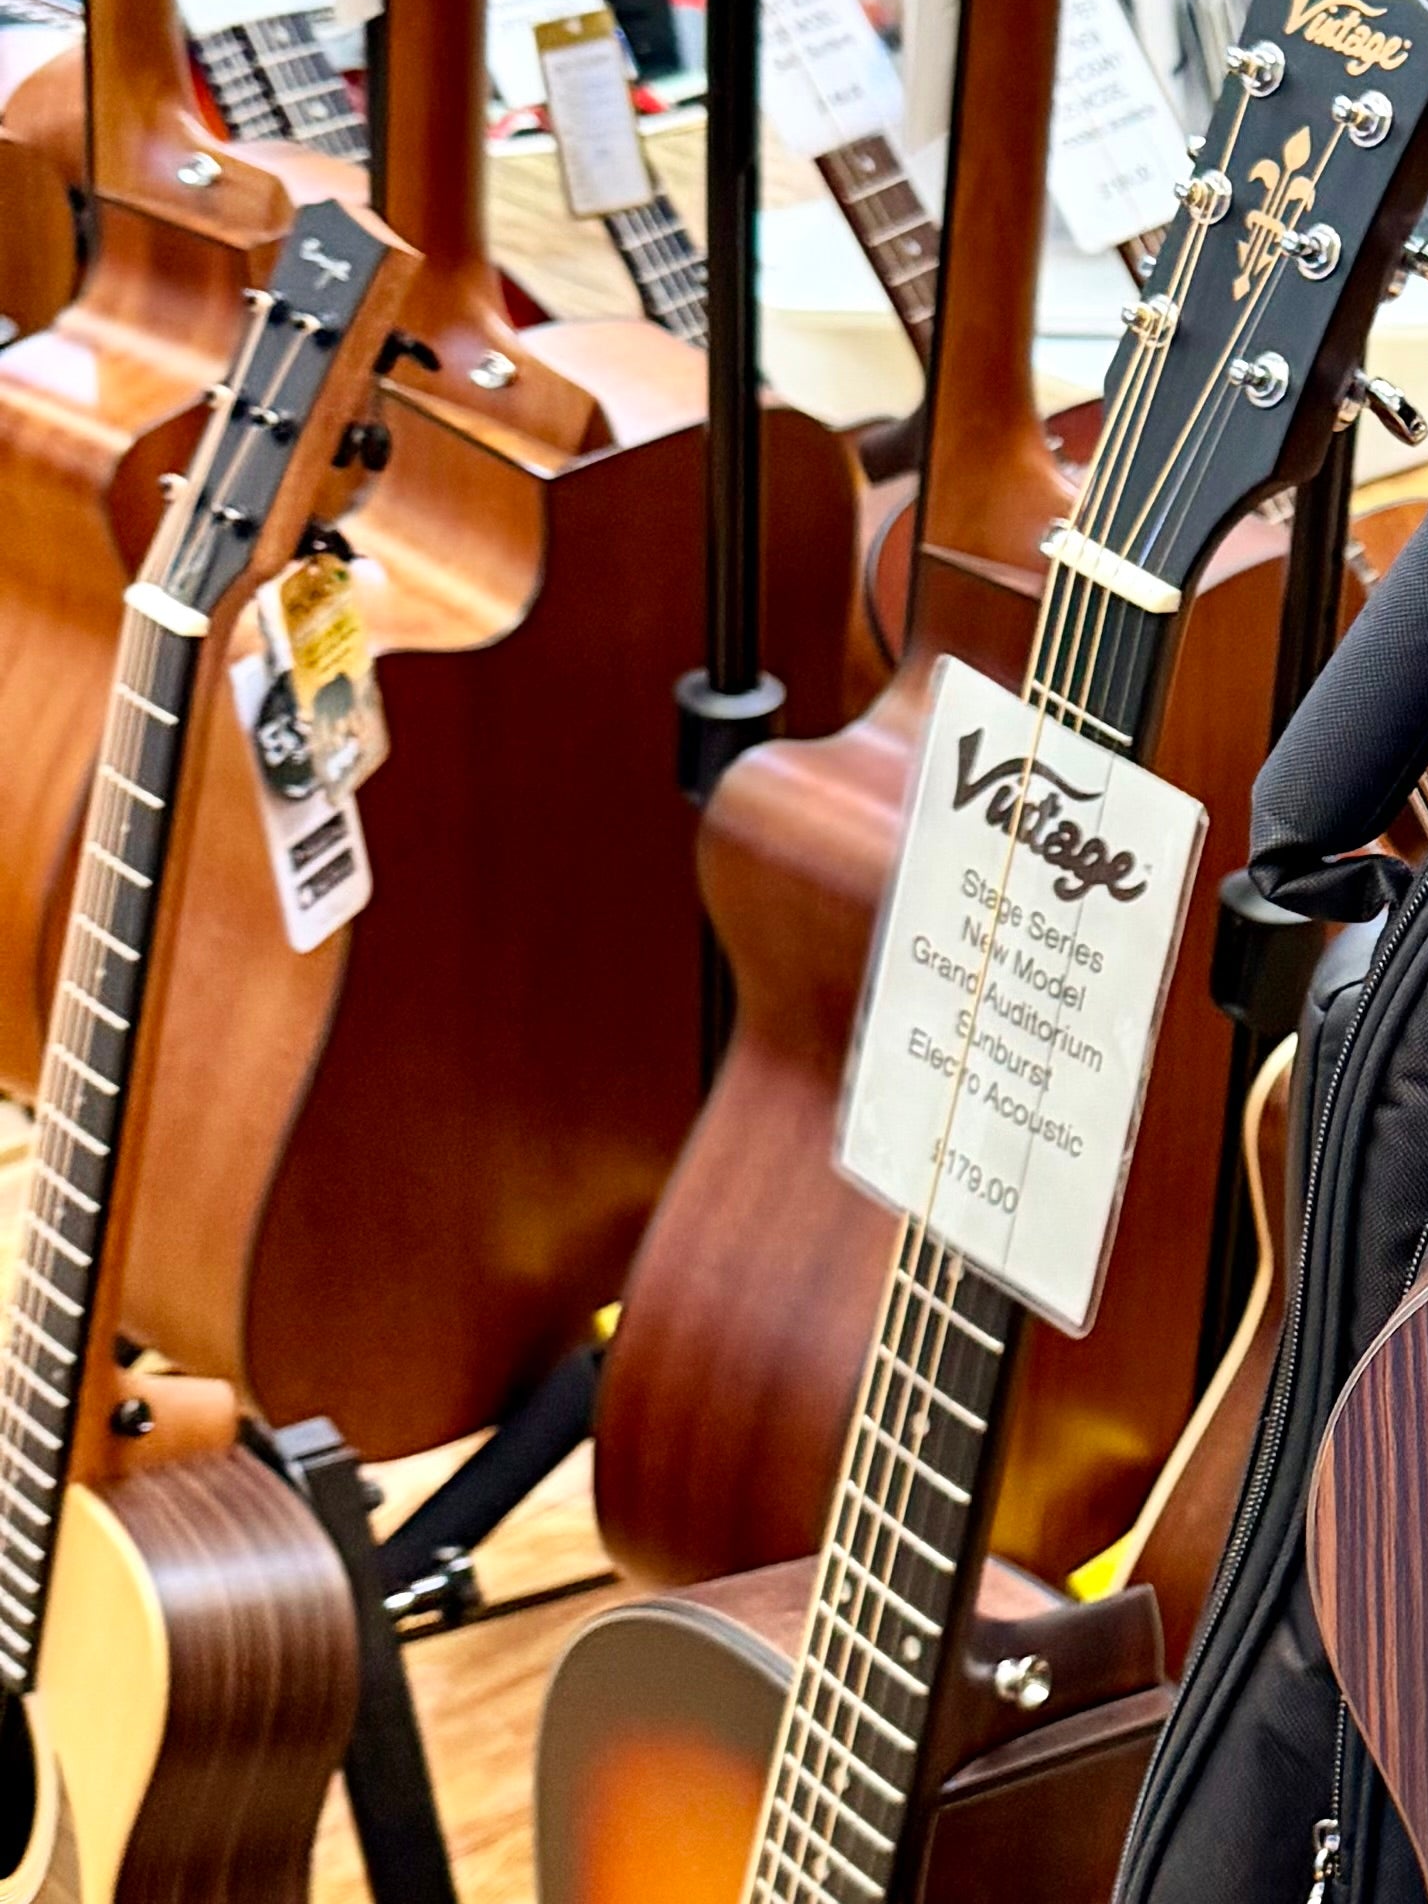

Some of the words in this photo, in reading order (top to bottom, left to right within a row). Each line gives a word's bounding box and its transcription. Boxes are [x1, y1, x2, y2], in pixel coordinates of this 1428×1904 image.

[953, 726, 1148, 902] Vintage
[961, 867, 1024, 928] Stage
[1029, 910, 1105, 975] Series
[961, 915, 1010, 966] New
[1012, 950, 1088, 1013] Model
[983, 982, 1104, 1073] Auditorium
[983, 1081, 1084, 1159] Acoustic
